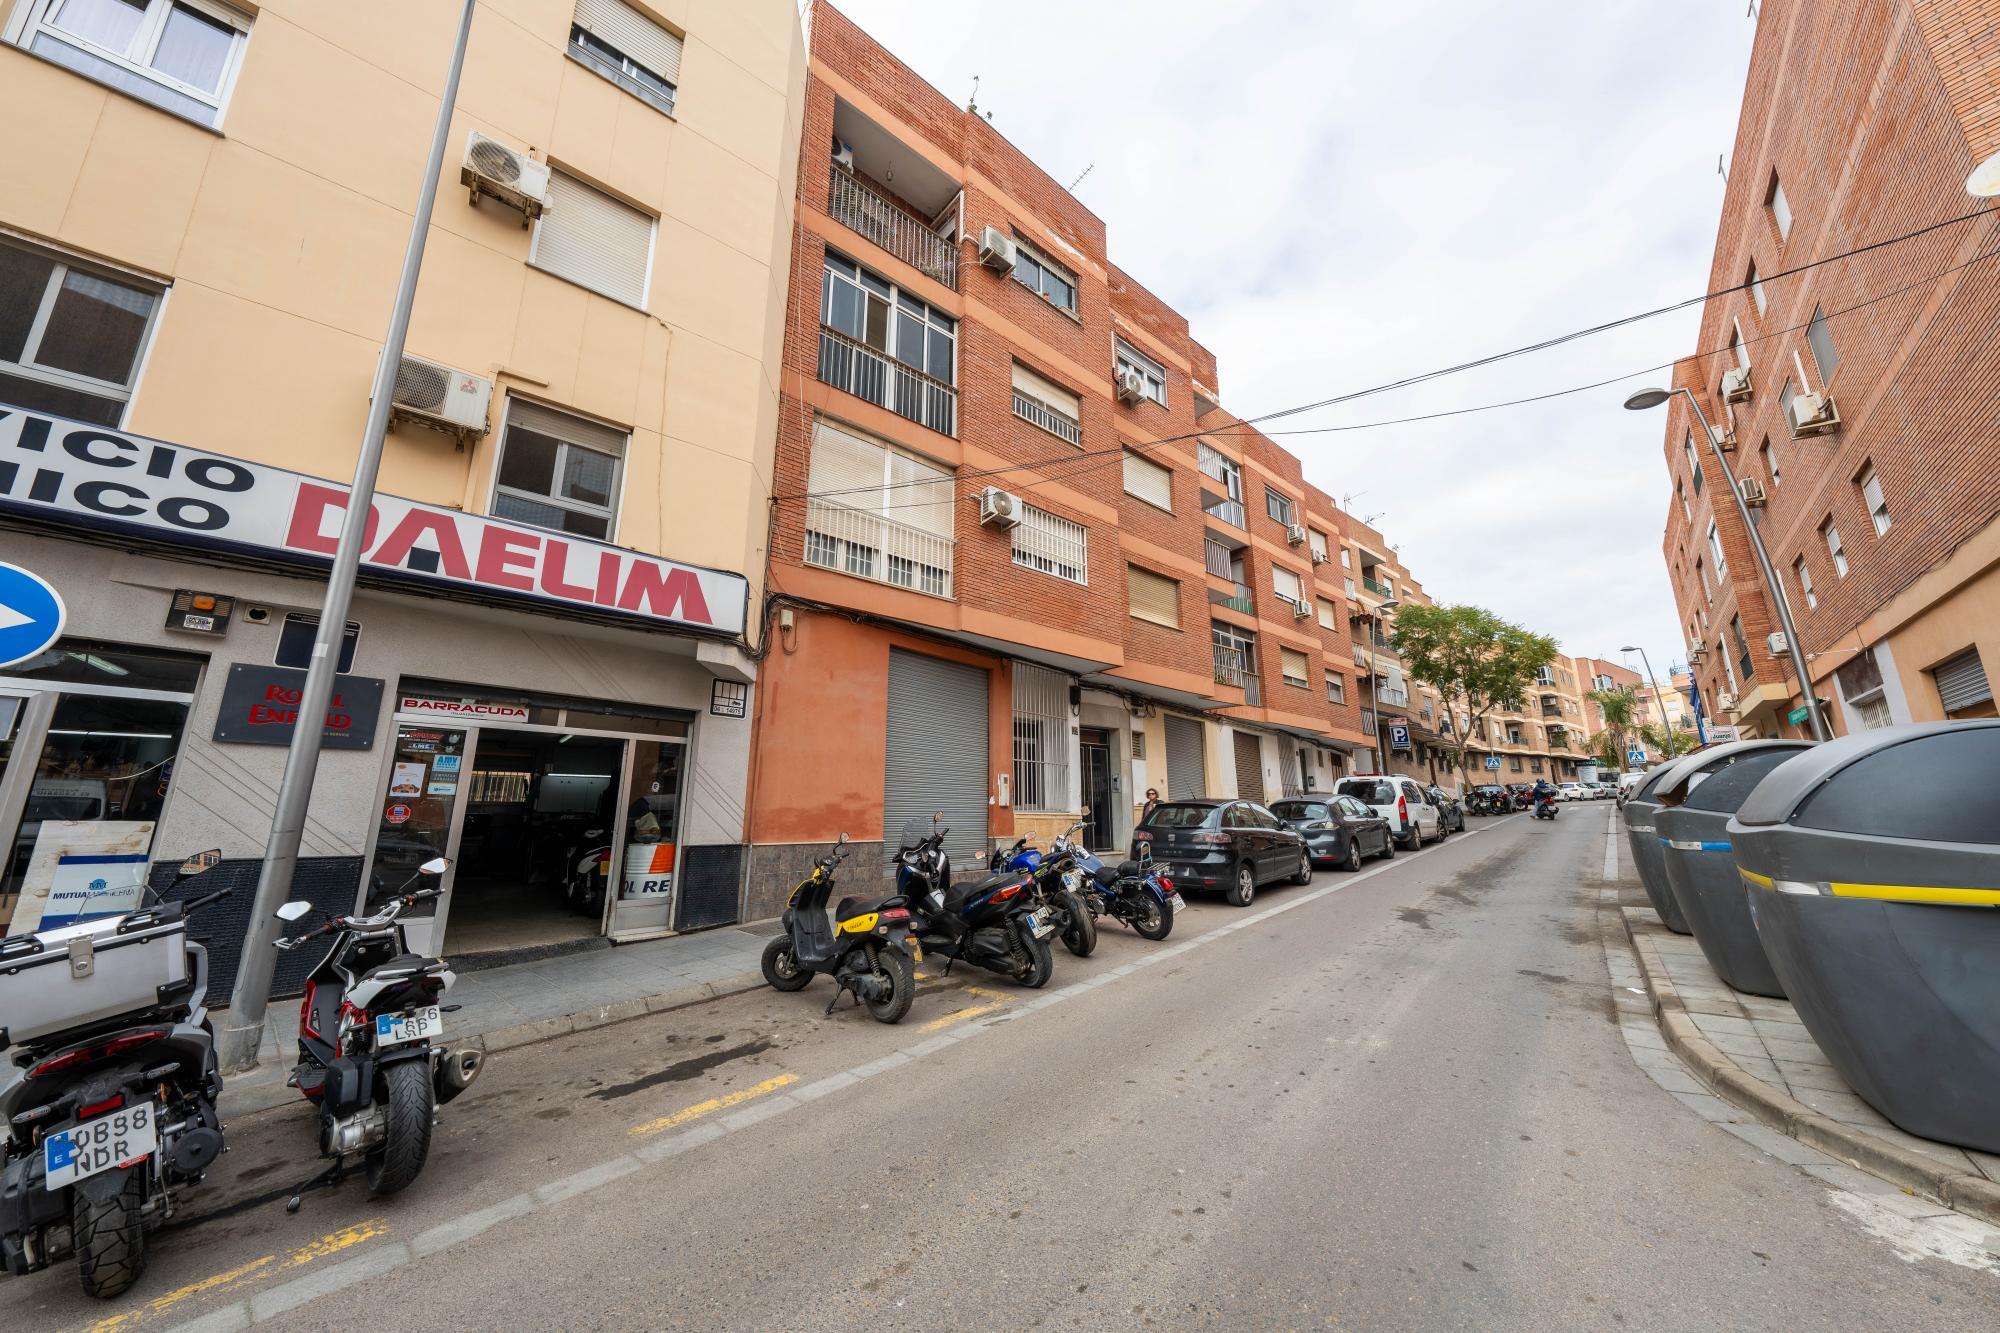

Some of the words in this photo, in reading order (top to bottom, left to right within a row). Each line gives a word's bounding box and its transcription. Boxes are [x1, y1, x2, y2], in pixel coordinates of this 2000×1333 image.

[285, 481, 713, 626] DAELIM
[248, 703, 353, 731] ENFLD
[403, 699, 526, 717] BARRACUDA
